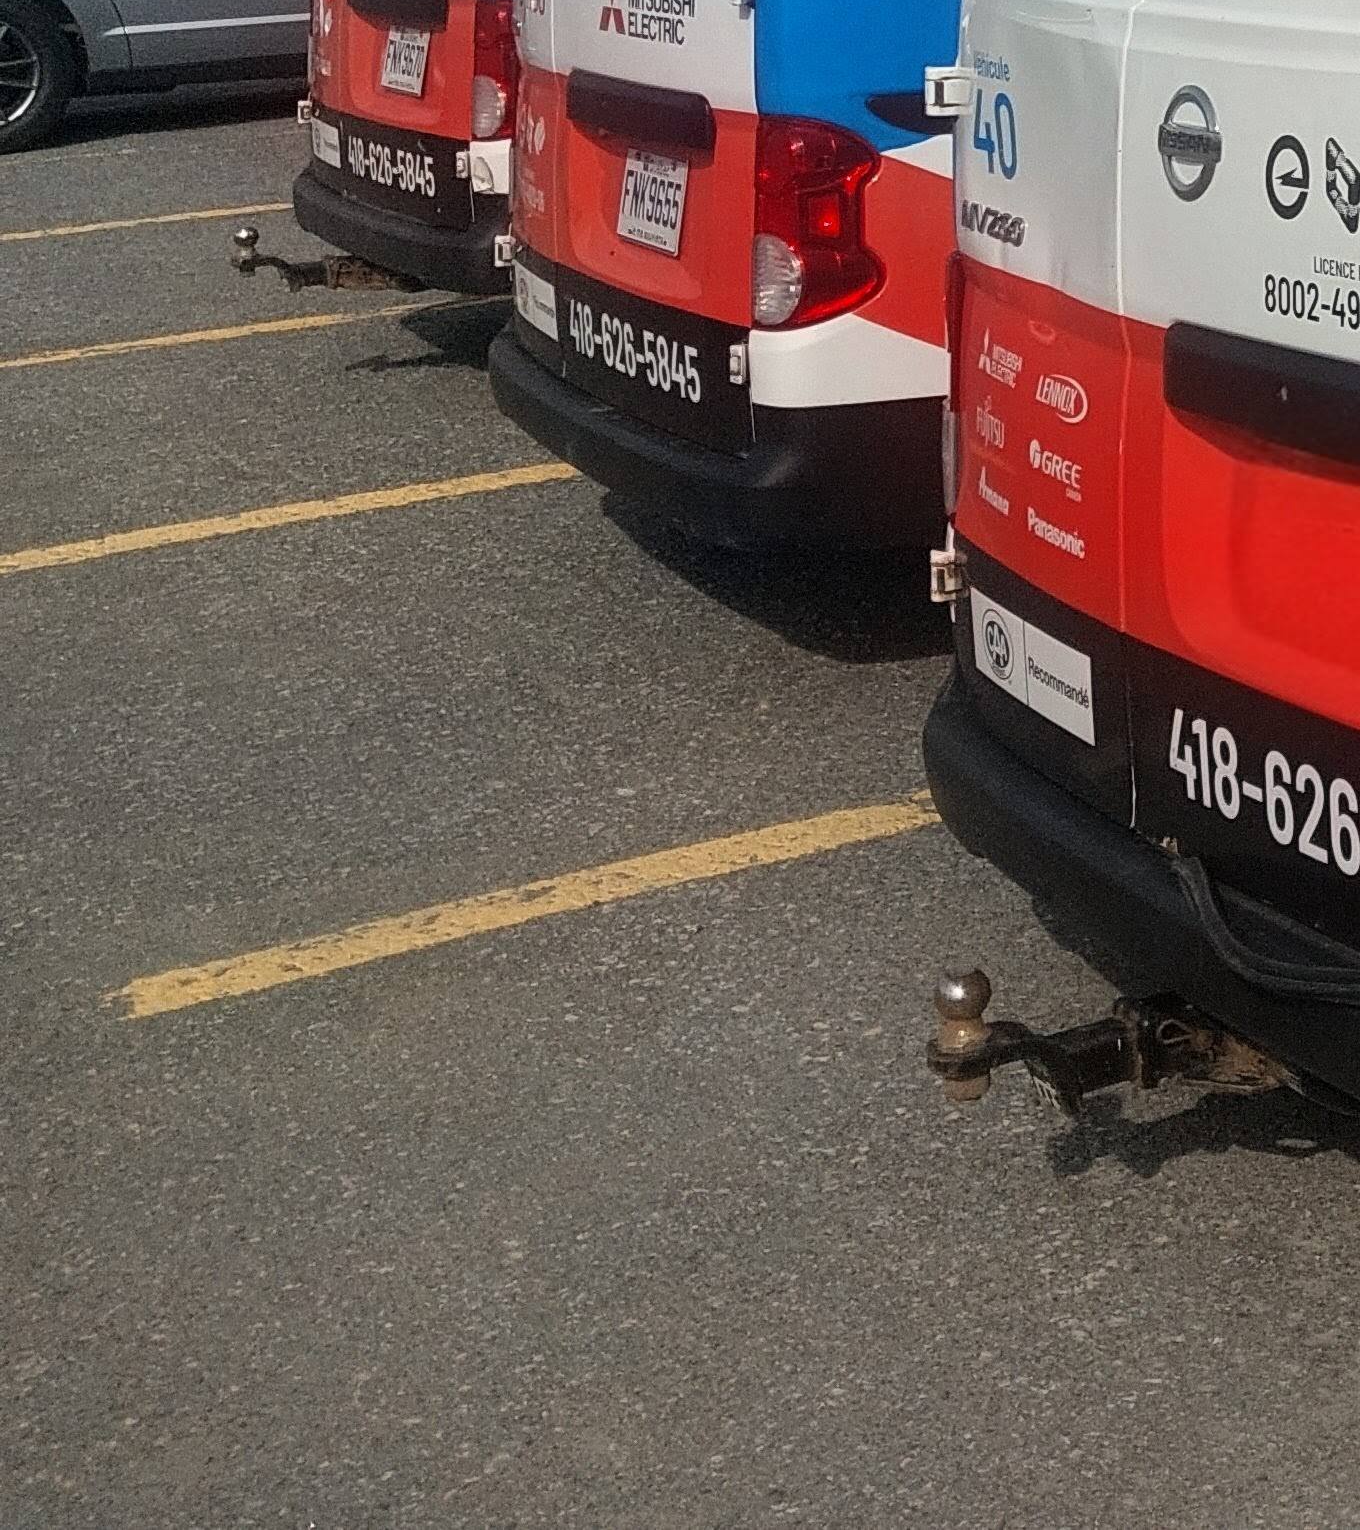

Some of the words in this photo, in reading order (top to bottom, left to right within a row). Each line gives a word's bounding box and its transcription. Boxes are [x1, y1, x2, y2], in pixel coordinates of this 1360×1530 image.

[628, 14, 686, 46] ELECTRIC
[973, 88, 1018, 181] 40
[348, 134, 436, 198] 418-626-5845
[622, 169, 682, 230] FNK9655
[1313, 256, 1356, 280] LICENCE
[569, 299, 701, 404] 418-626-5845
[1035, 374, 1078, 416] LENNOX
[1041, 450, 1083, 489] GREE
[1027, 506, 1086, 559] Panasonic
[1028, 656, 1090, 709] Recommandé
